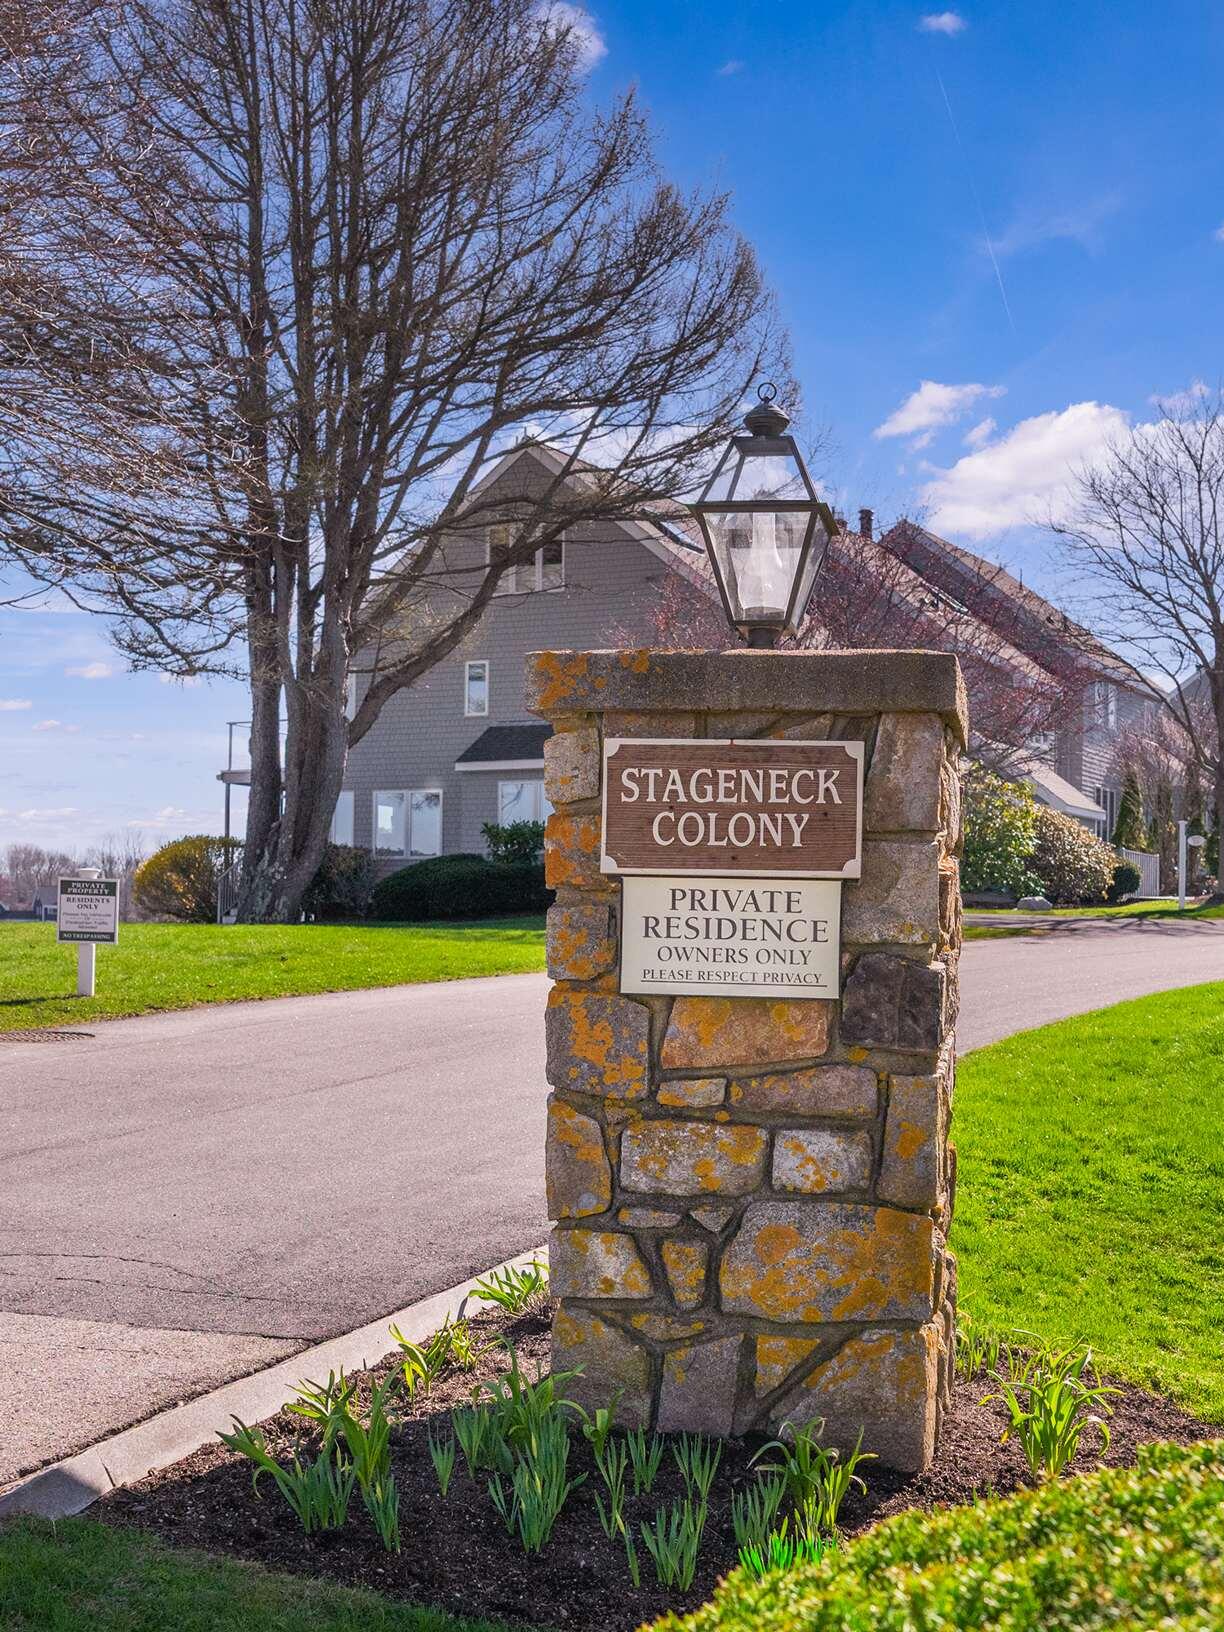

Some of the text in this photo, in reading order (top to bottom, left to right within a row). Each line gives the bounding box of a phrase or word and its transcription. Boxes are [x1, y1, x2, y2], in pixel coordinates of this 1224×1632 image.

[621, 767, 842, 804] STAGENECK
[652, 811, 810, 847] COLONY
[669, 888, 803, 914] PRIVATE
[642, 915, 829, 943] RESIDENCE
[657, 945, 812, 965] OWNERS ONLY
[642, 968, 822, 984] PLEASE RESPECT PRIVACY
